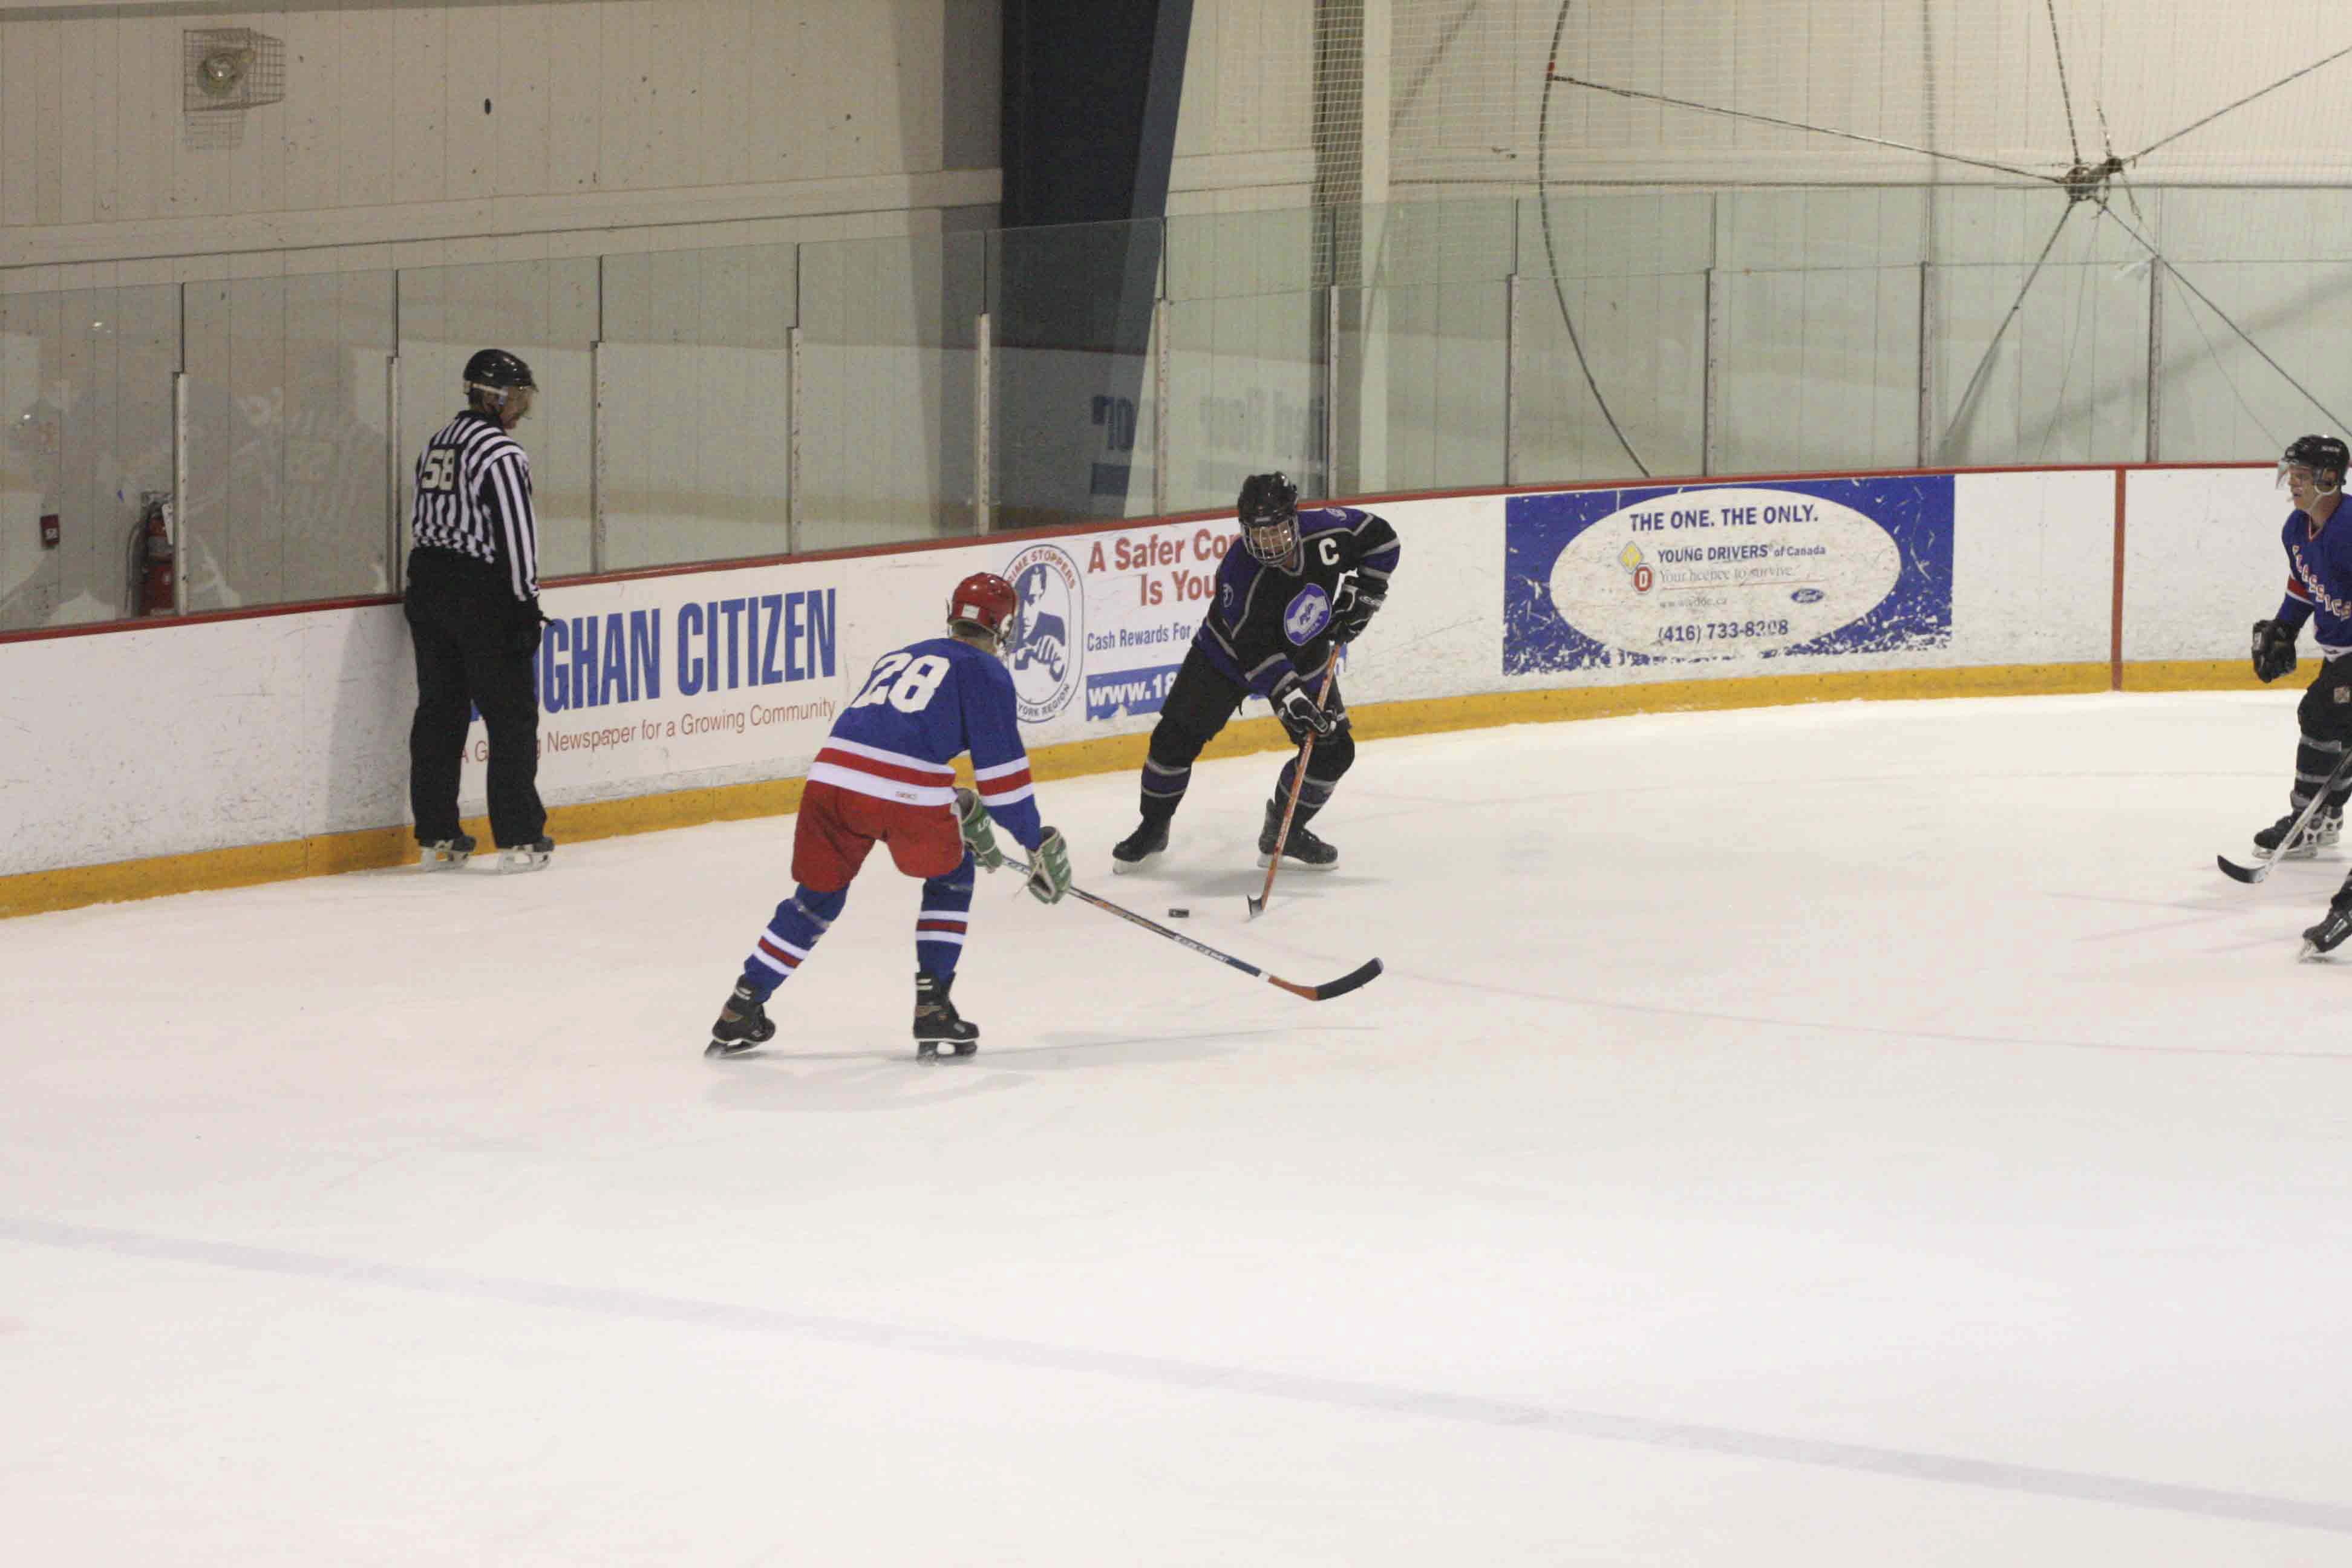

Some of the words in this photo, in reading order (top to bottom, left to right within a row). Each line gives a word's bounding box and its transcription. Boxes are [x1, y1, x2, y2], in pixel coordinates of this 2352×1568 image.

[422, 449, 454, 491] 58
[1630, 512, 1665, 531] THE
[1671, 509, 1714, 529] ONE.
[1722, 507, 1757, 526] THE
[1763, 505, 1818, 524] ONLY.
[1088, 541, 1106, 573] A
[1115, 534, 1186, 570] Safer
[1194, 529, 1241, 561] Co
[1319, 537, 1340, 566] C
[1658, 547, 1703, 563] YOUNG
[1774, 546, 1785, 557] of
[1787, 544, 1826, 556] Canada
[1006, 555, 1030, 582] RIME
[1031, 549, 1076, 589] STOPPERS
[1660, 569, 1686, 583] Your
[1734, 567, 1747, 580] to
[1141, 574, 1163, 606] Is
[1087, 630, 1116, 652] Cash
[1120, 624, 1169, 647] Rewards
[1173, 622, 1191, 641] For
[1659, 625, 1702, 644] (416)
[533, 609, 661, 714] GHAN
[678, 589, 836, 696] CITIZEN
[851, 652, 950, 713] 28
[1018, 702, 1039, 717] YORK
[1041, 683, 1070, 713] REGION
[547, 725, 636, 753] Newspaper
[641, 719, 662, 740] for
[666, 720, 676, 737] a
[681, 709, 745, 734] Growing
[750, 696, 836, 727] Community
